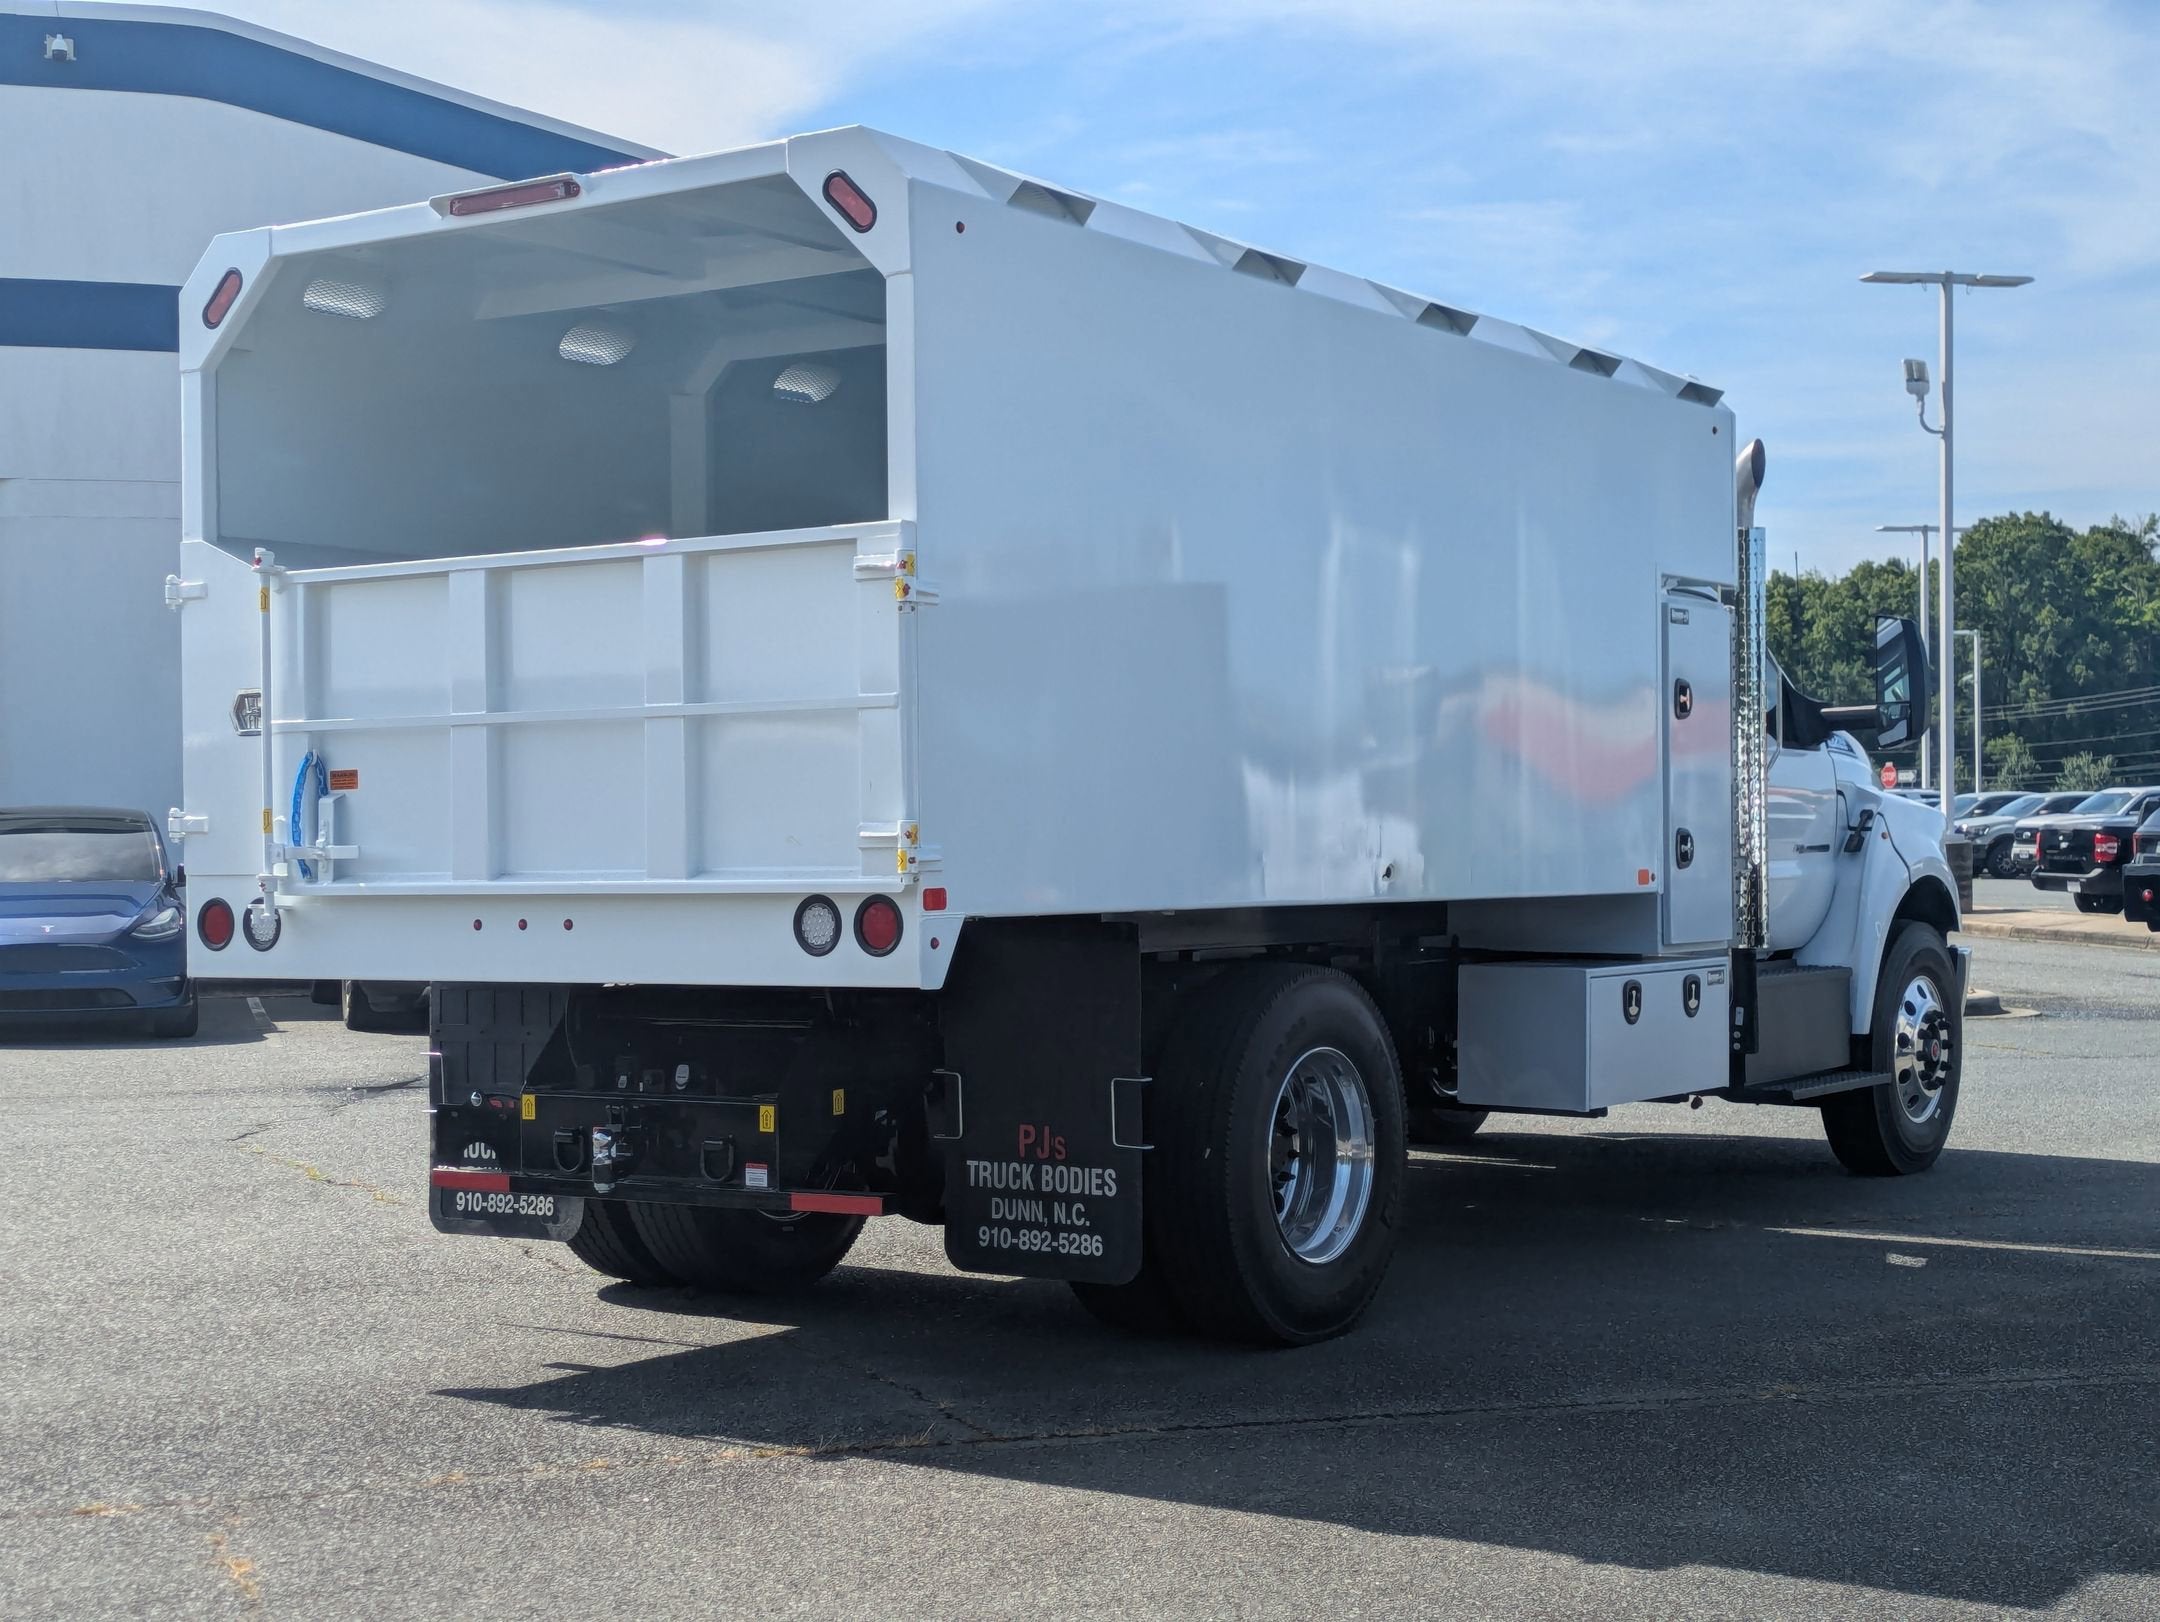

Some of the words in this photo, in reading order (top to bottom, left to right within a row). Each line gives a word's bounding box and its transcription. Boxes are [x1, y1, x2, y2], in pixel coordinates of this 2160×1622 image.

[966, 1160, 1035, 1191] TRUCK
[1041, 1165, 1117, 1197] BODIES
[456, 1191, 554, 1217] 910-892-5286
[991, 1197, 1048, 1227] DUNN,
[1053, 1201, 1091, 1227] N.C.
[979, 1226, 1103, 1257] 910-892-5286
